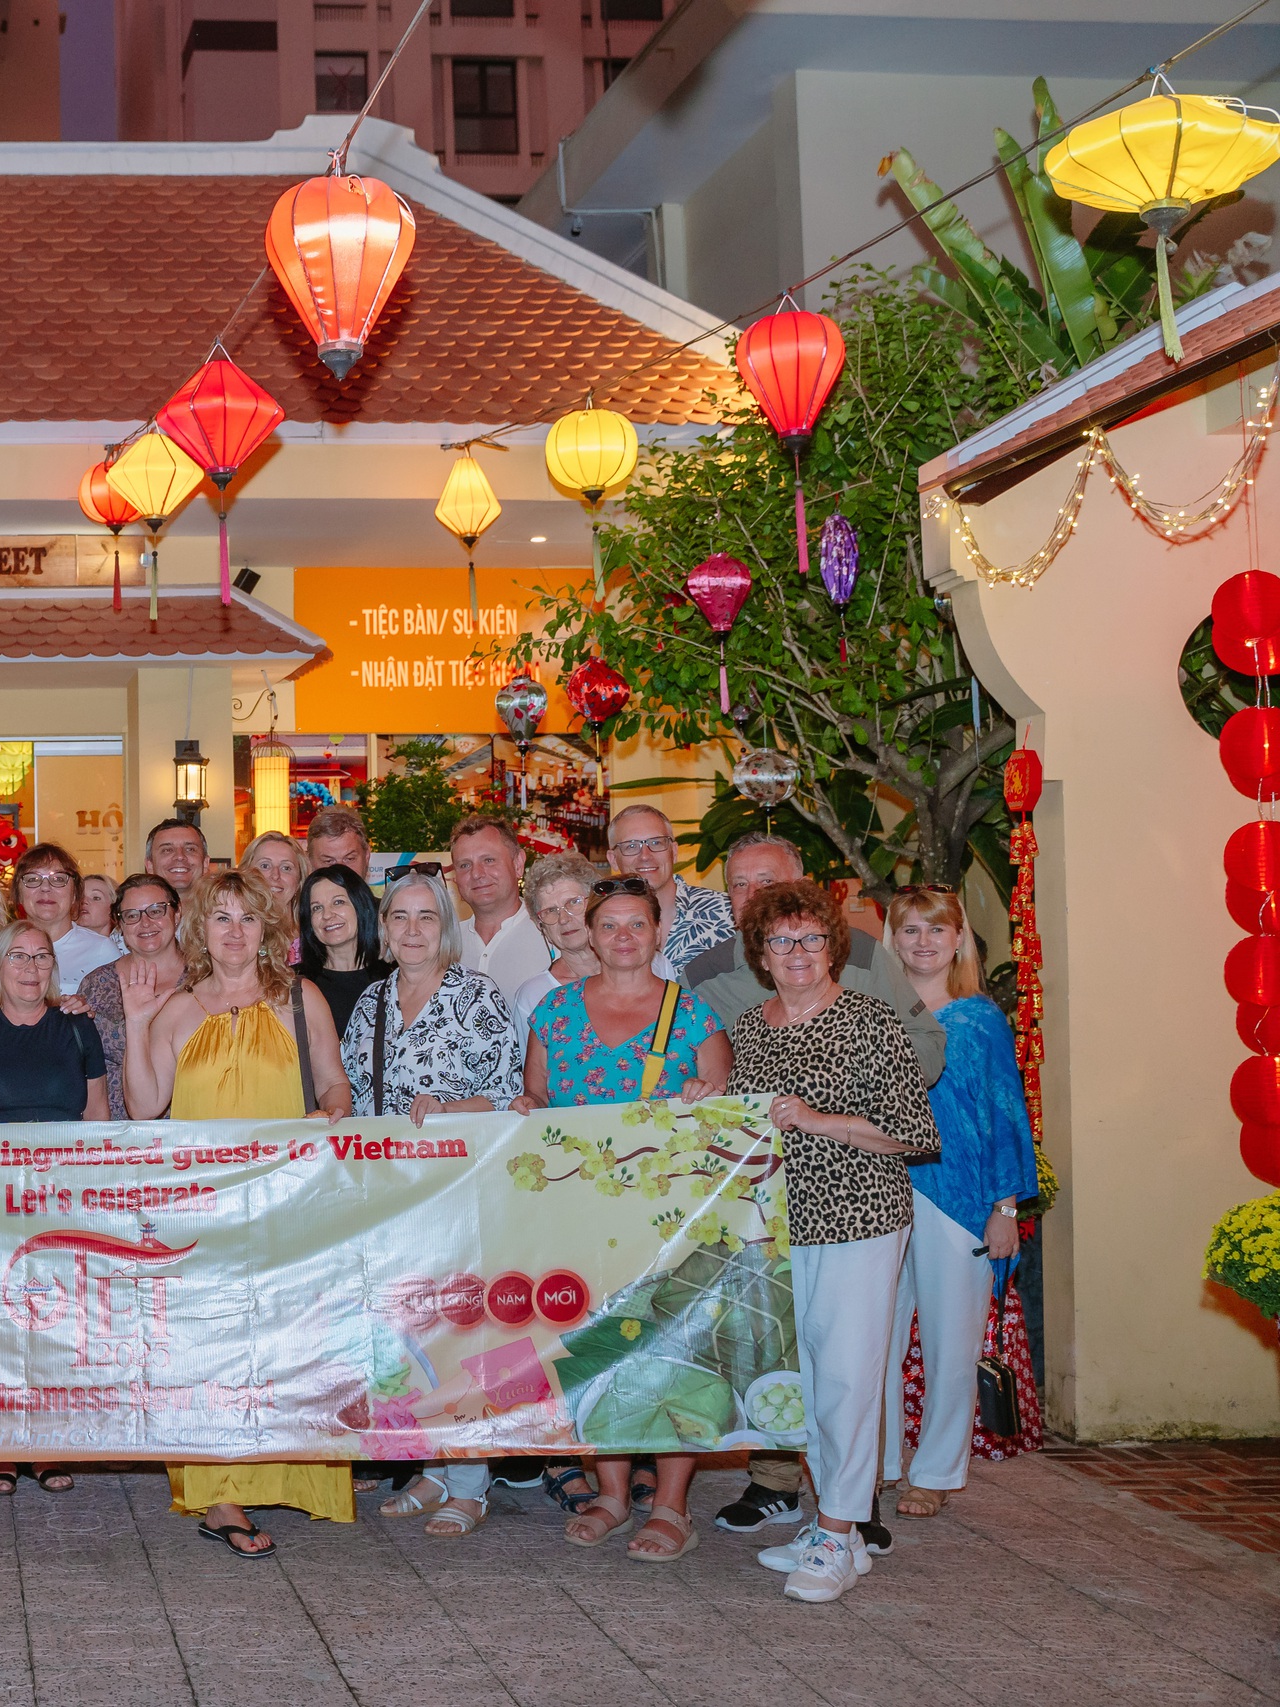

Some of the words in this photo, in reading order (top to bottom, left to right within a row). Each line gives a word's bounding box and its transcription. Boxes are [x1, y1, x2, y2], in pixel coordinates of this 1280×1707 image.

[362, 604, 399, 639] TIỆC
[403, 603, 449, 635] BÀN/
[478, 604, 518, 639] KIỆN
[361, 656, 408, 691] NHẬN
[412, 655, 445, 691] ĐẶT
[448, 655, 485, 690] TIỆC
[172, 1139, 278, 1170] guests
[287, 1138, 319, 1163] to
[326, 1133, 468, 1161] Vietnam
[6, 1183, 72, 1215] Let's
[81, 1182, 217, 1213] celebrate
[496, 1290, 526, 1305] NĂM
[544, 1286, 577, 1305] MỚI
[95, 1341, 171, 1368] 2025
[129, 1380, 194, 1411] New
[10, 1429, 63, 1446] Minh
